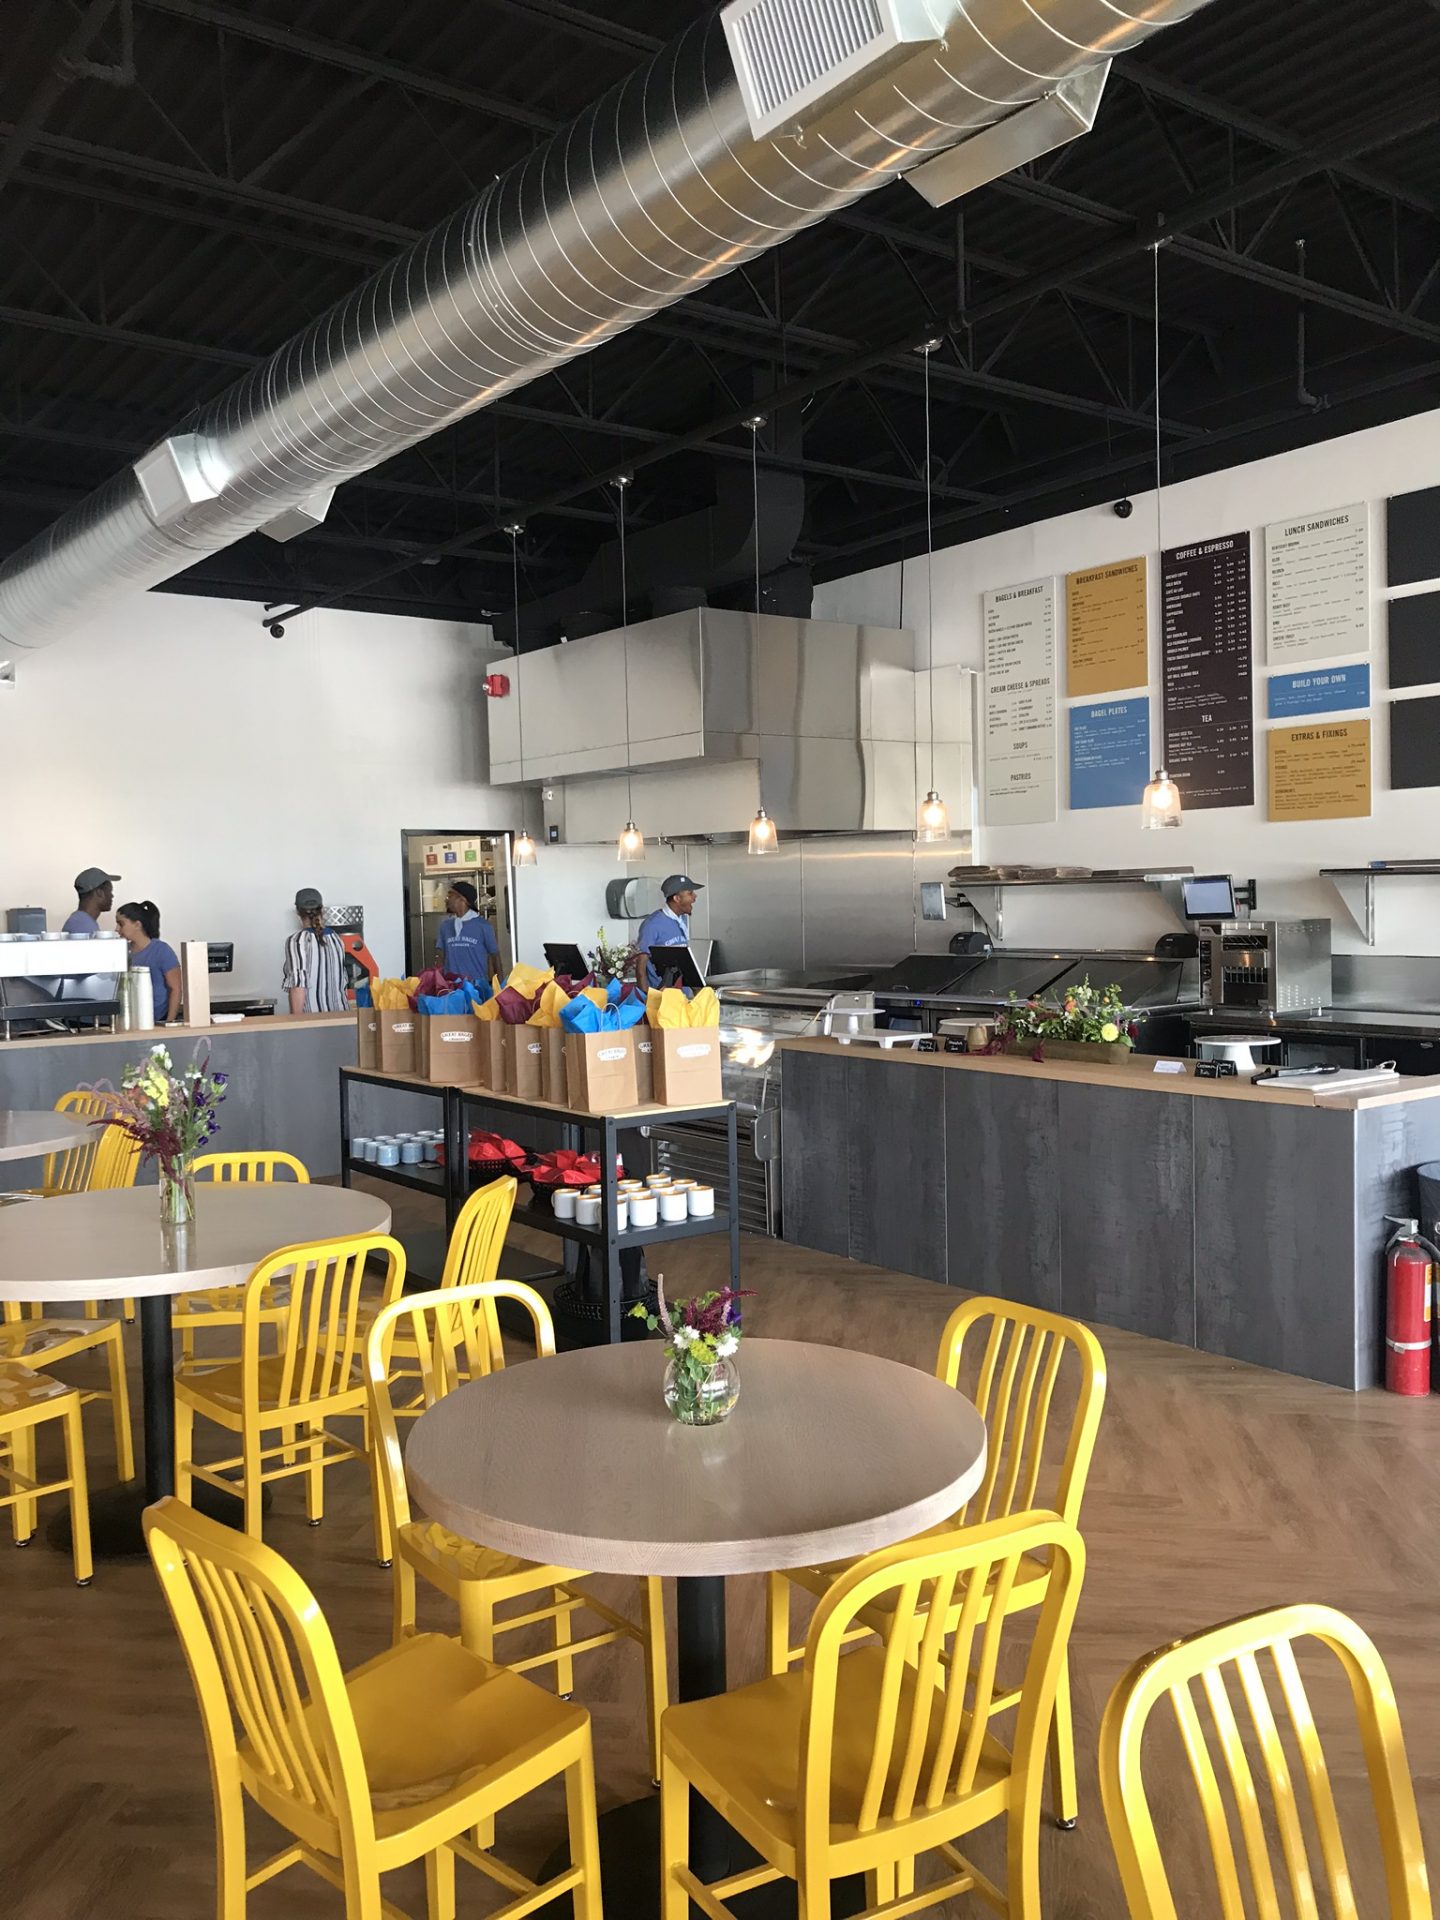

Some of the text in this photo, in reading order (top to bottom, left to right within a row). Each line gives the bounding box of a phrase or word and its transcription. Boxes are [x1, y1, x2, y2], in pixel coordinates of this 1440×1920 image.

[1284, 514, 1349, 537] LUNCH SANDWICHES
[1176, 540, 1234, 560] COFFEE & ESPRESSO
[1076, 564, 1138, 585] BREAKFAST SANDWICHES
[995, 592, 1012, 603] BAGELS
[1018, 585, 1044, 598] BREAKFAST
[990, 685, 1006, 694] CREAM
[1007, 681, 1024, 691] CHEESE
[1029, 677, 1051, 687] SPREADS
[1292, 674, 1346, 689] BUILD YOUR OWN
[1090, 706, 1128, 718] BAGEL PLATES
[1201, 714, 1213, 723] TEA
[1291, 728, 1348, 742] EXTRAS & FIXINGS
[1013, 741, 1028, 750] SOUPS
[1010, 772, 1032, 781] PASTRIES
